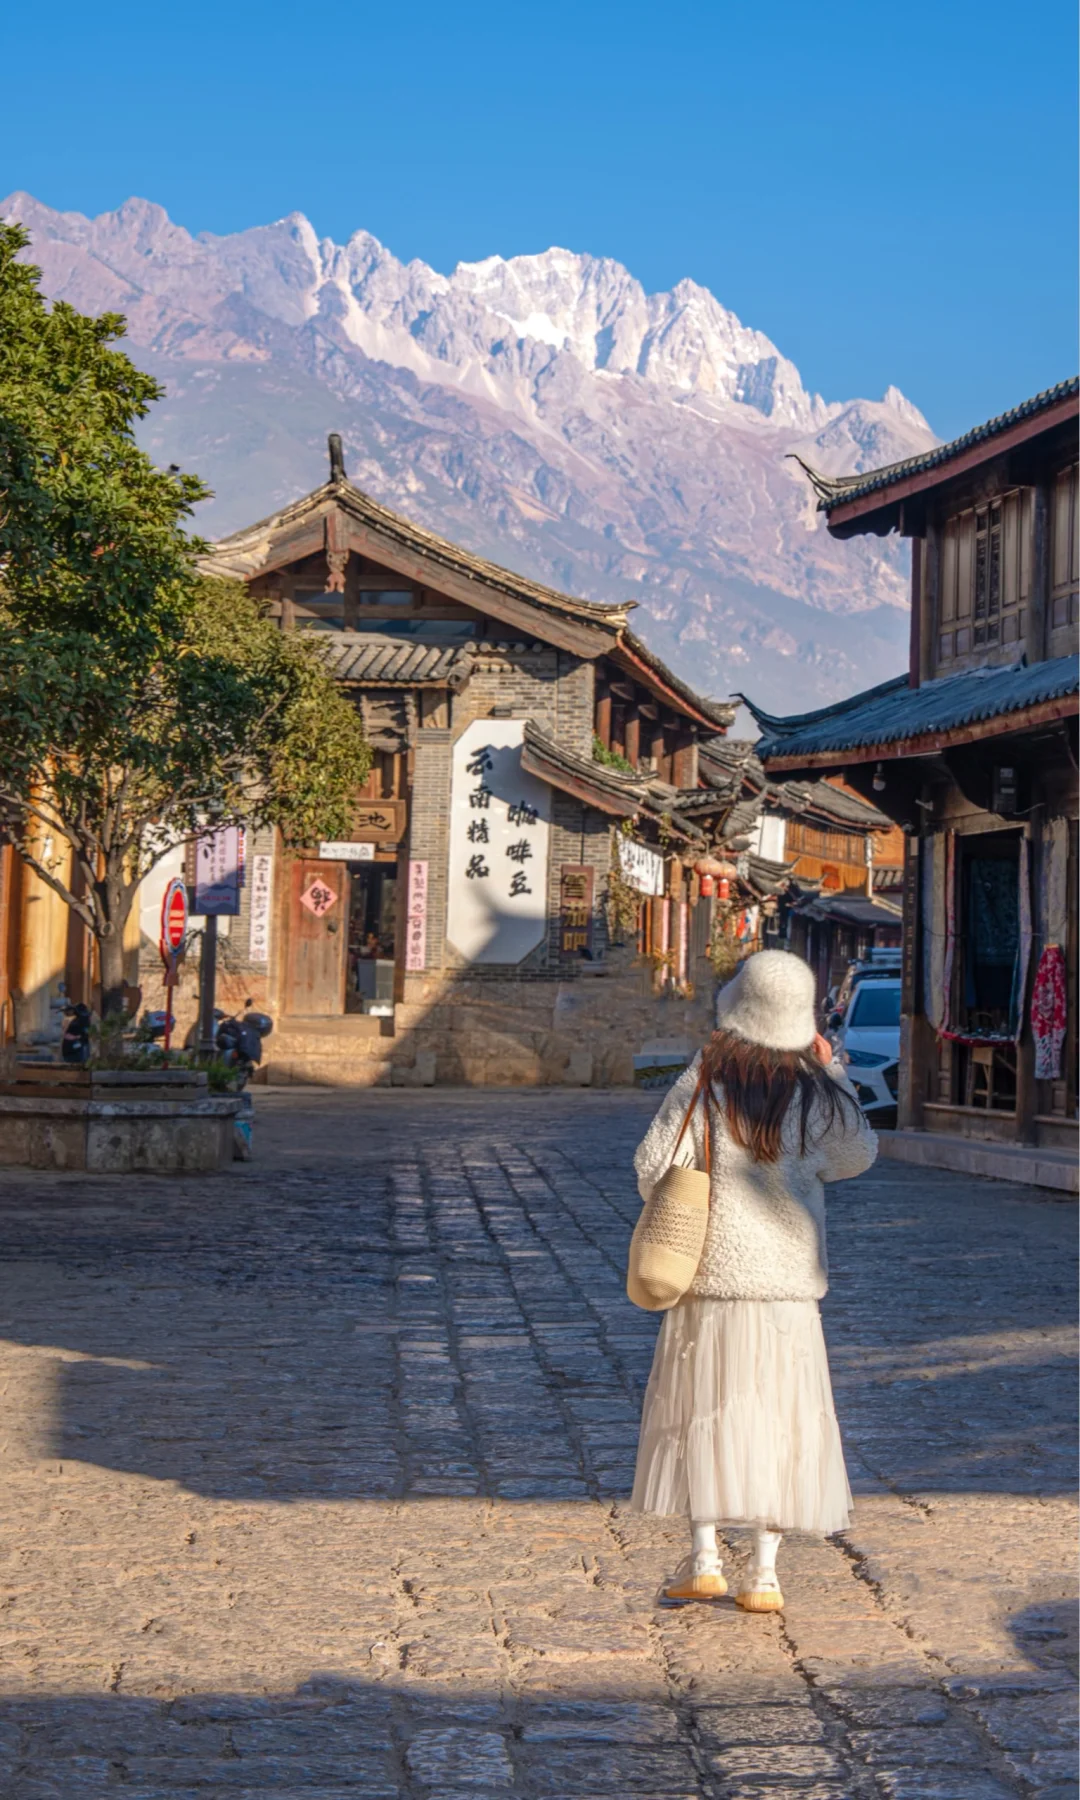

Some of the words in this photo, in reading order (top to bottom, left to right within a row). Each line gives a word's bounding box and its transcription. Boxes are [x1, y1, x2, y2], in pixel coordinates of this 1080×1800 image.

[466, 746, 493, 879] 云南精品
[506, 800, 539, 897] 咖啡豆
